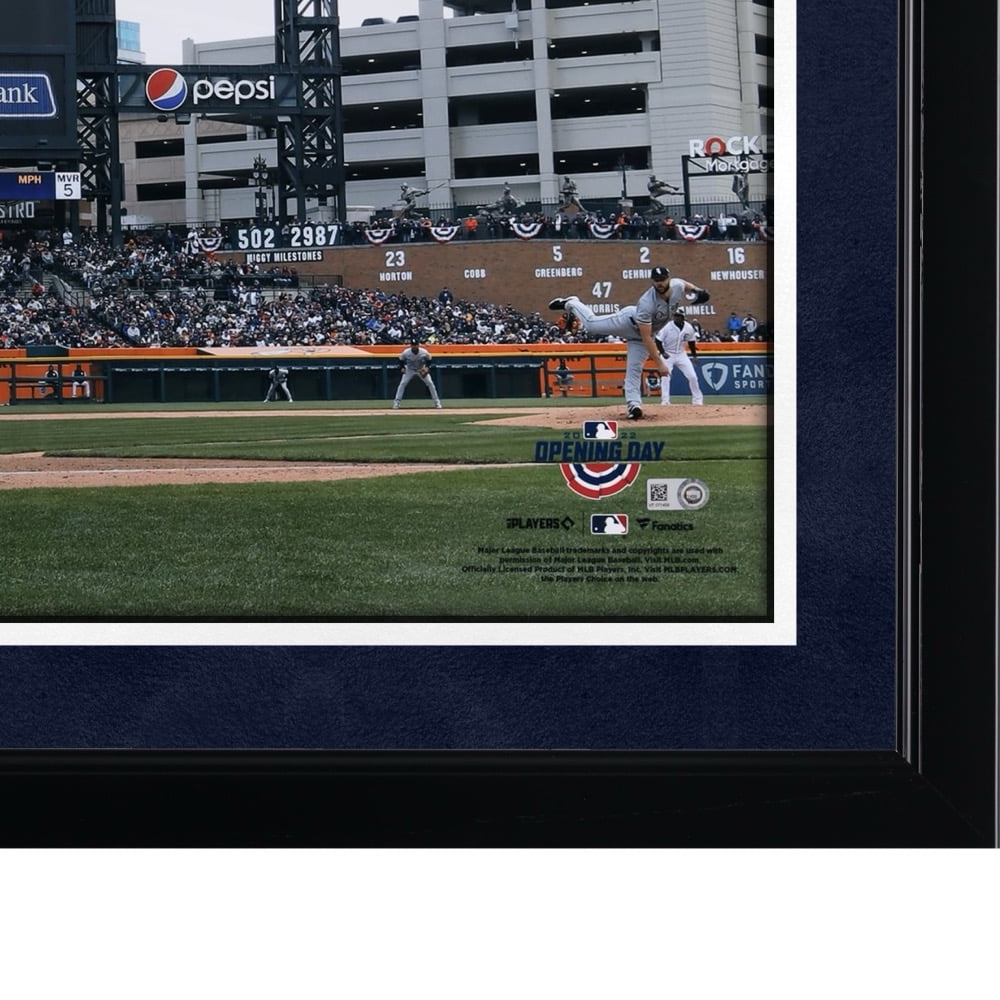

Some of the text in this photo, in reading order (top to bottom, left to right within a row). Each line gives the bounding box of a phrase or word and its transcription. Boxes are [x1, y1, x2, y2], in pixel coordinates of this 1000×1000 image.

[194, 75, 275, 104] pepsi
[18, 174, 42, 184] MPH
[56, 174, 80, 183] MVR
[238, 226, 338, 248] 502 2987
[274, 251, 322, 263] MILESTONES
[386, 251, 405, 267] 23
[552, 246, 563, 262] 5
[640, 247, 650, 264] 2
[728, 248, 745, 264] 16
[380, 272, 412, 282] HORTON
[464, 269, 486, 278] COBB
[535, 268, 582, 278] GREENBERG
[710, 270, 764, 280] NEWHOUSER
[592, 282, 612, 299] 47
[734, 380, 768, 388] SPOR
